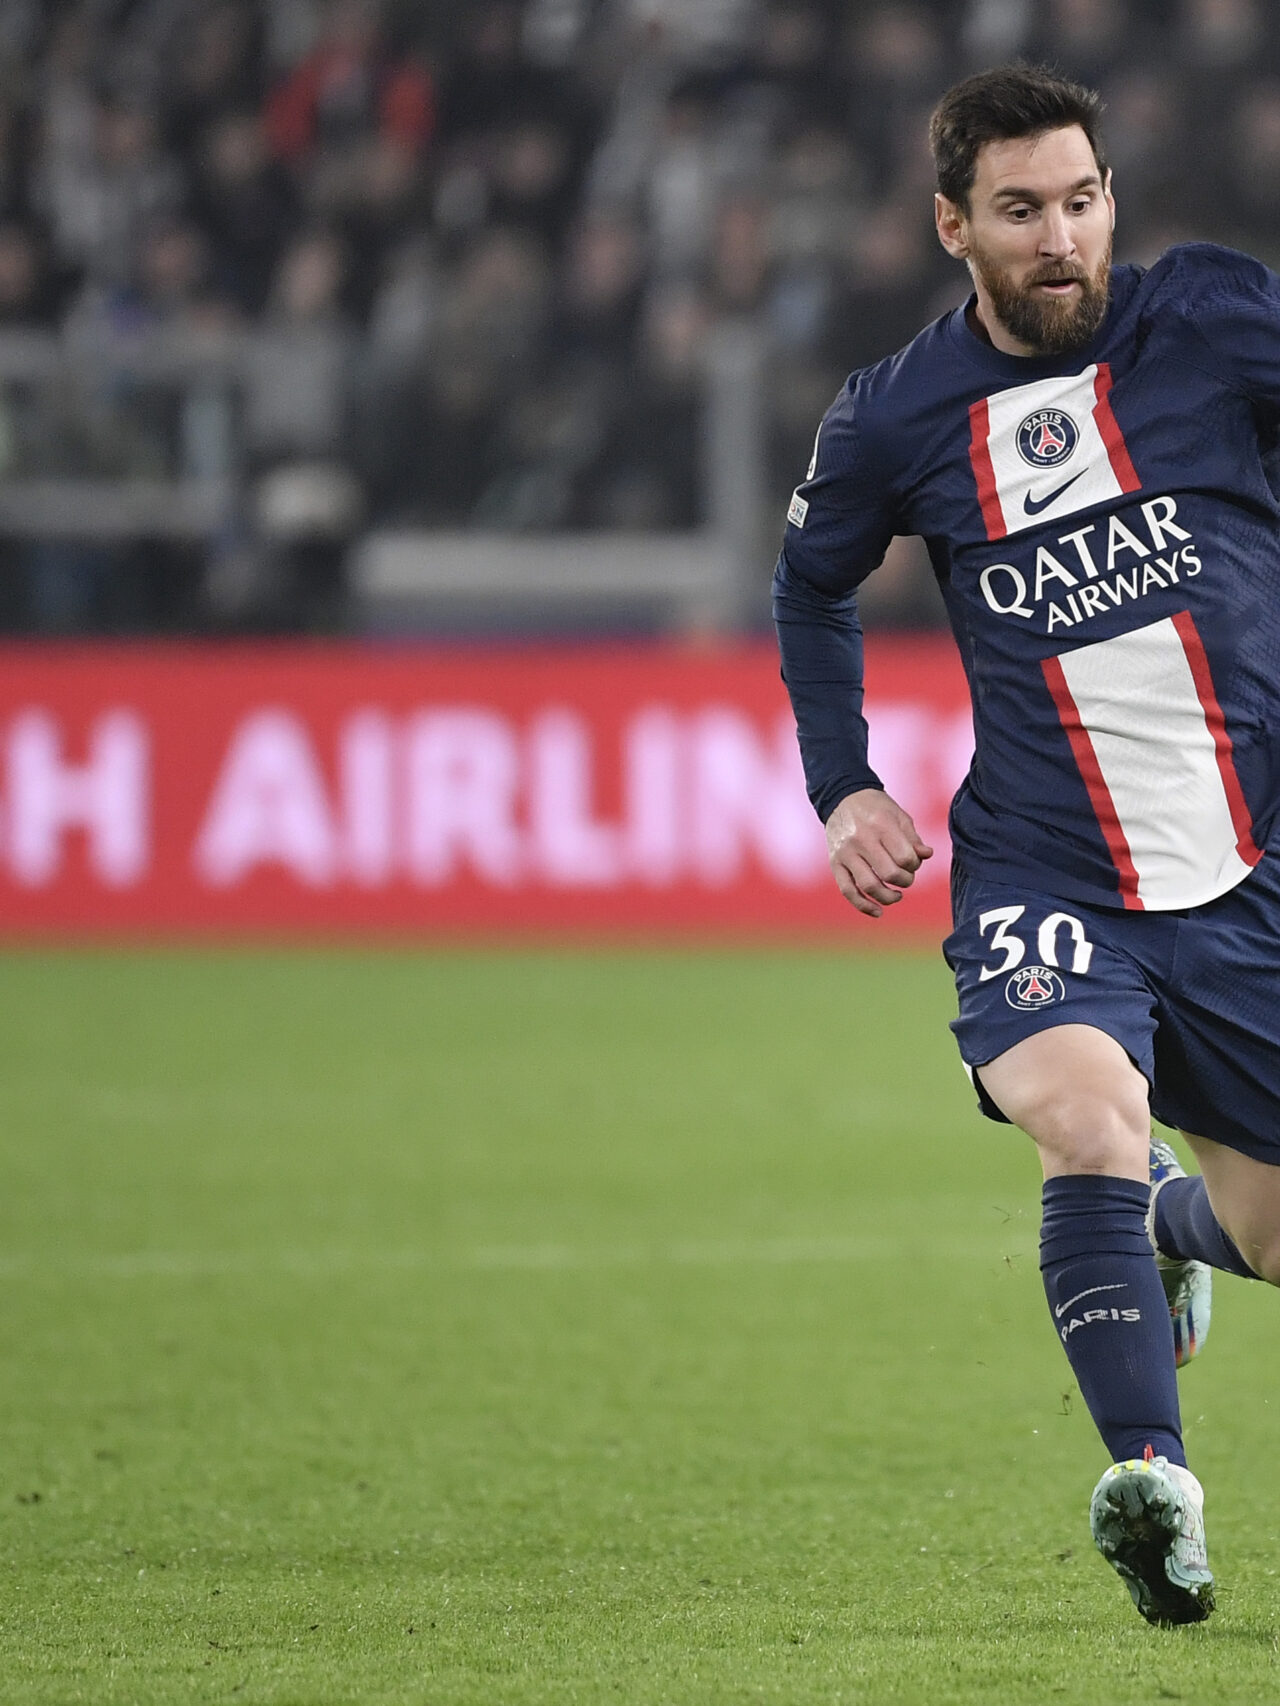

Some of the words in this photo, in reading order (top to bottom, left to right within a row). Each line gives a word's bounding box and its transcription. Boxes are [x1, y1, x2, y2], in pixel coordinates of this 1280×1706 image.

[1024, 413, 1062, 431] PARIS
[979, 496, 1192, 618] QATAR
[1047, 545, 1202, 633] AIRWAYS
[195, 705, 978, 890] AIRLIN
[979, 905, 1093, 982] 30
[1013, 968, 1054, 983] PARIS
[1061, 1308, 1140, 1342] PARIS
